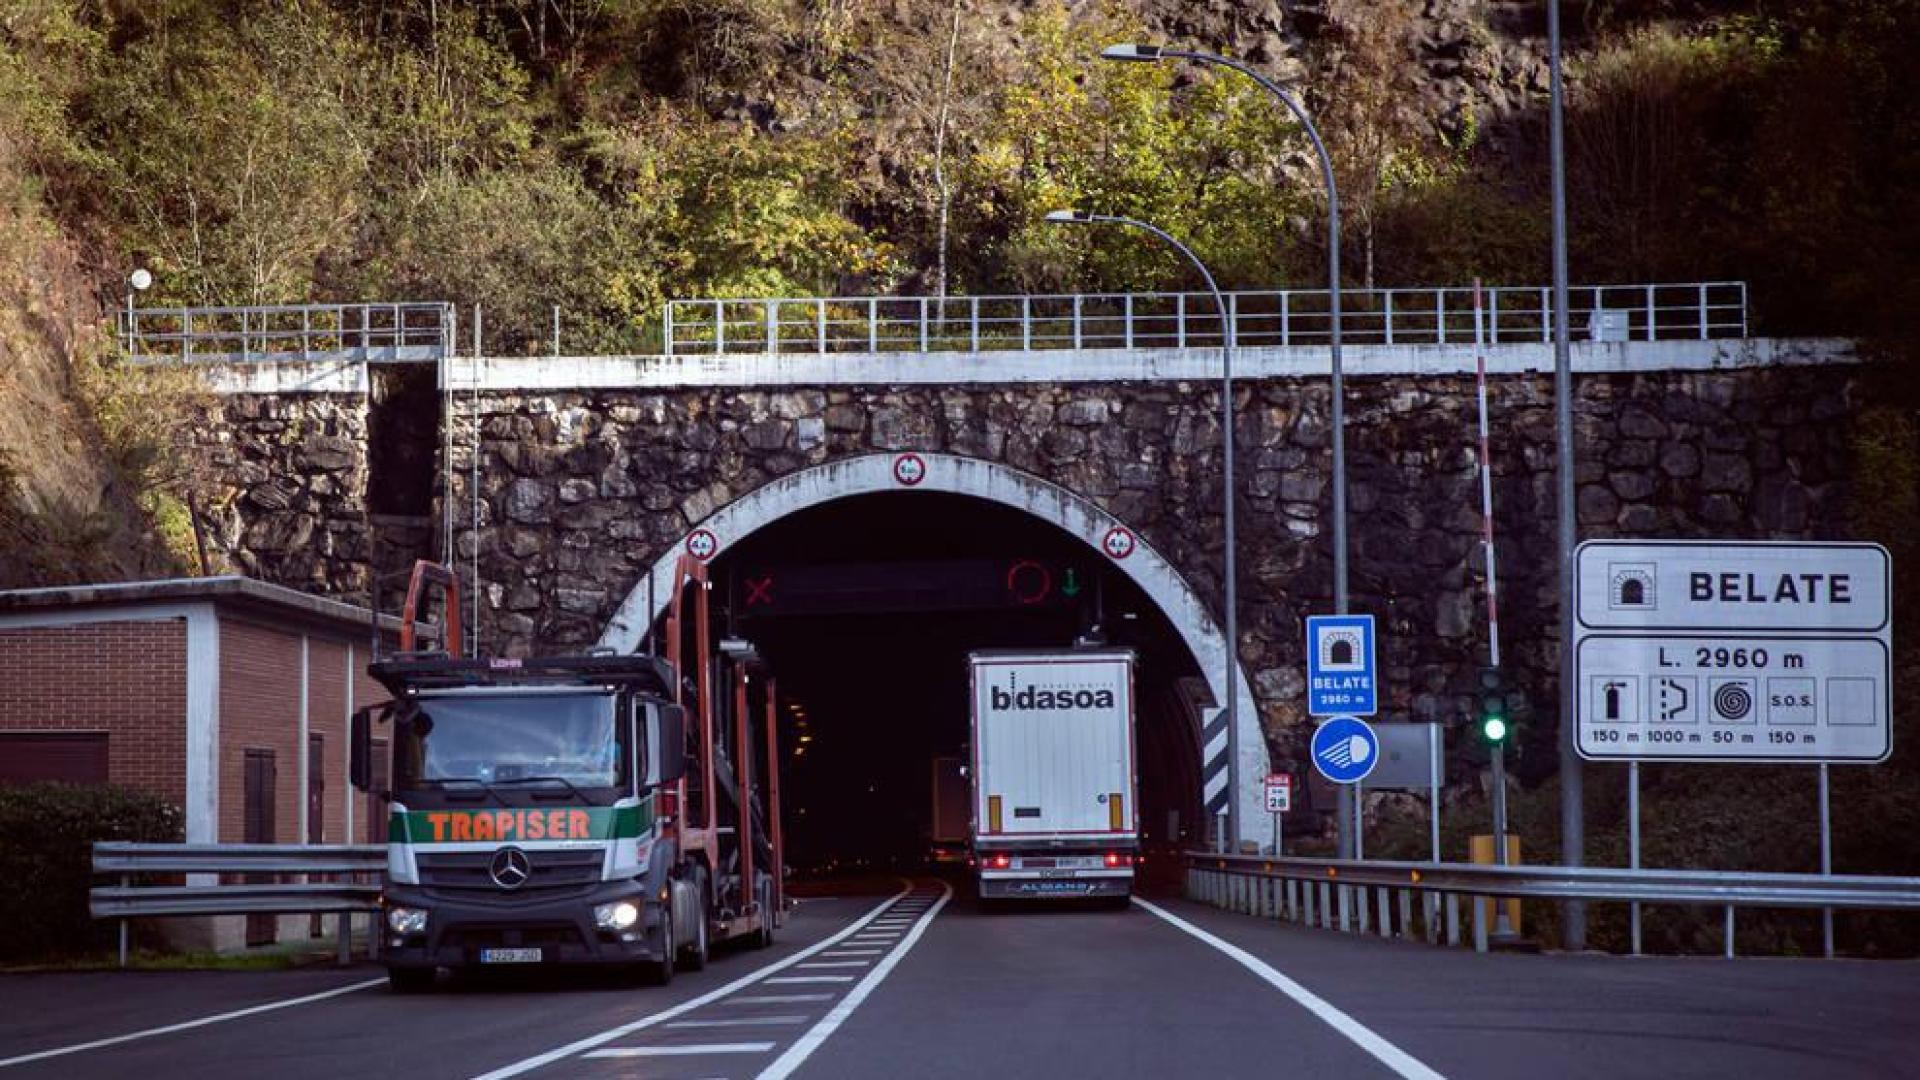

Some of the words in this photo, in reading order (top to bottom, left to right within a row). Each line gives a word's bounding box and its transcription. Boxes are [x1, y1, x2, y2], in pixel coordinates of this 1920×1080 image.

[1690, 571, 1852, 604] BELATE
[1658, 647, 1682, 668] L.
[1696, 648, 1768, 668] 2960
[1783, 652, 1804, 668] m
[1313, 676, 1370, 689] BELATE
[991, 671, 1114, 711] bidasoa
[1771, 695, 1813, 708] S.O.S.
[1592, 730, 1619, 743] 150
[1626, 733, 1640, 743] m
[1647, 730, 1685, 743] 1000
[1688, 733, 1702, 743] m
[1713, 731, 1733, 744] 50
[1739, 734, 1754, 744] m
[1768, 731, 1795, 744] 150
[1803, 734, 1816, 744] m
[427, 809, 590, 841] TRAPISER
